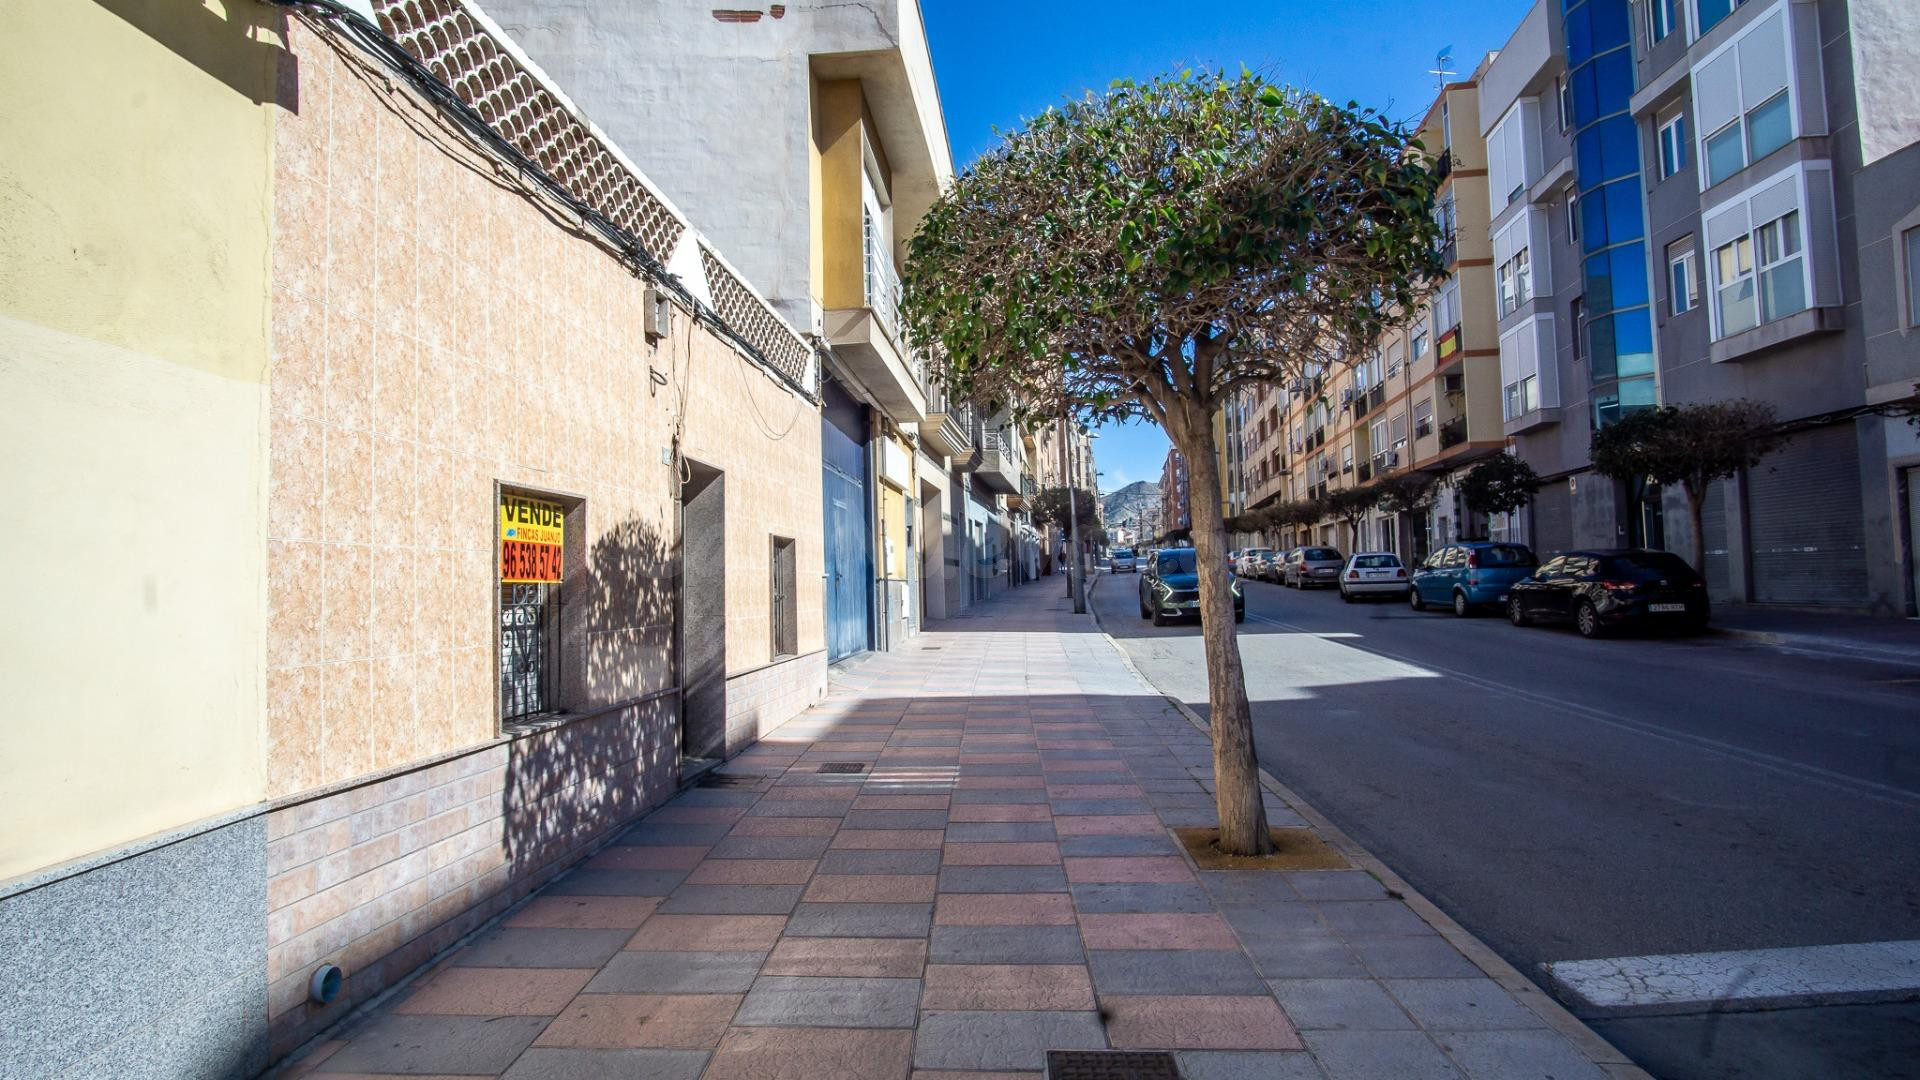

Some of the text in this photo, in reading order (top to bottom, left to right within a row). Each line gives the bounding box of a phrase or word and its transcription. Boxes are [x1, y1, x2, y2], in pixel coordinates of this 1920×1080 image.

[504, 497, 561, 528] VENDE
[517, 527, 539, 541] FINCAS
[503, 541, 561, 580] 96 538 57 42
